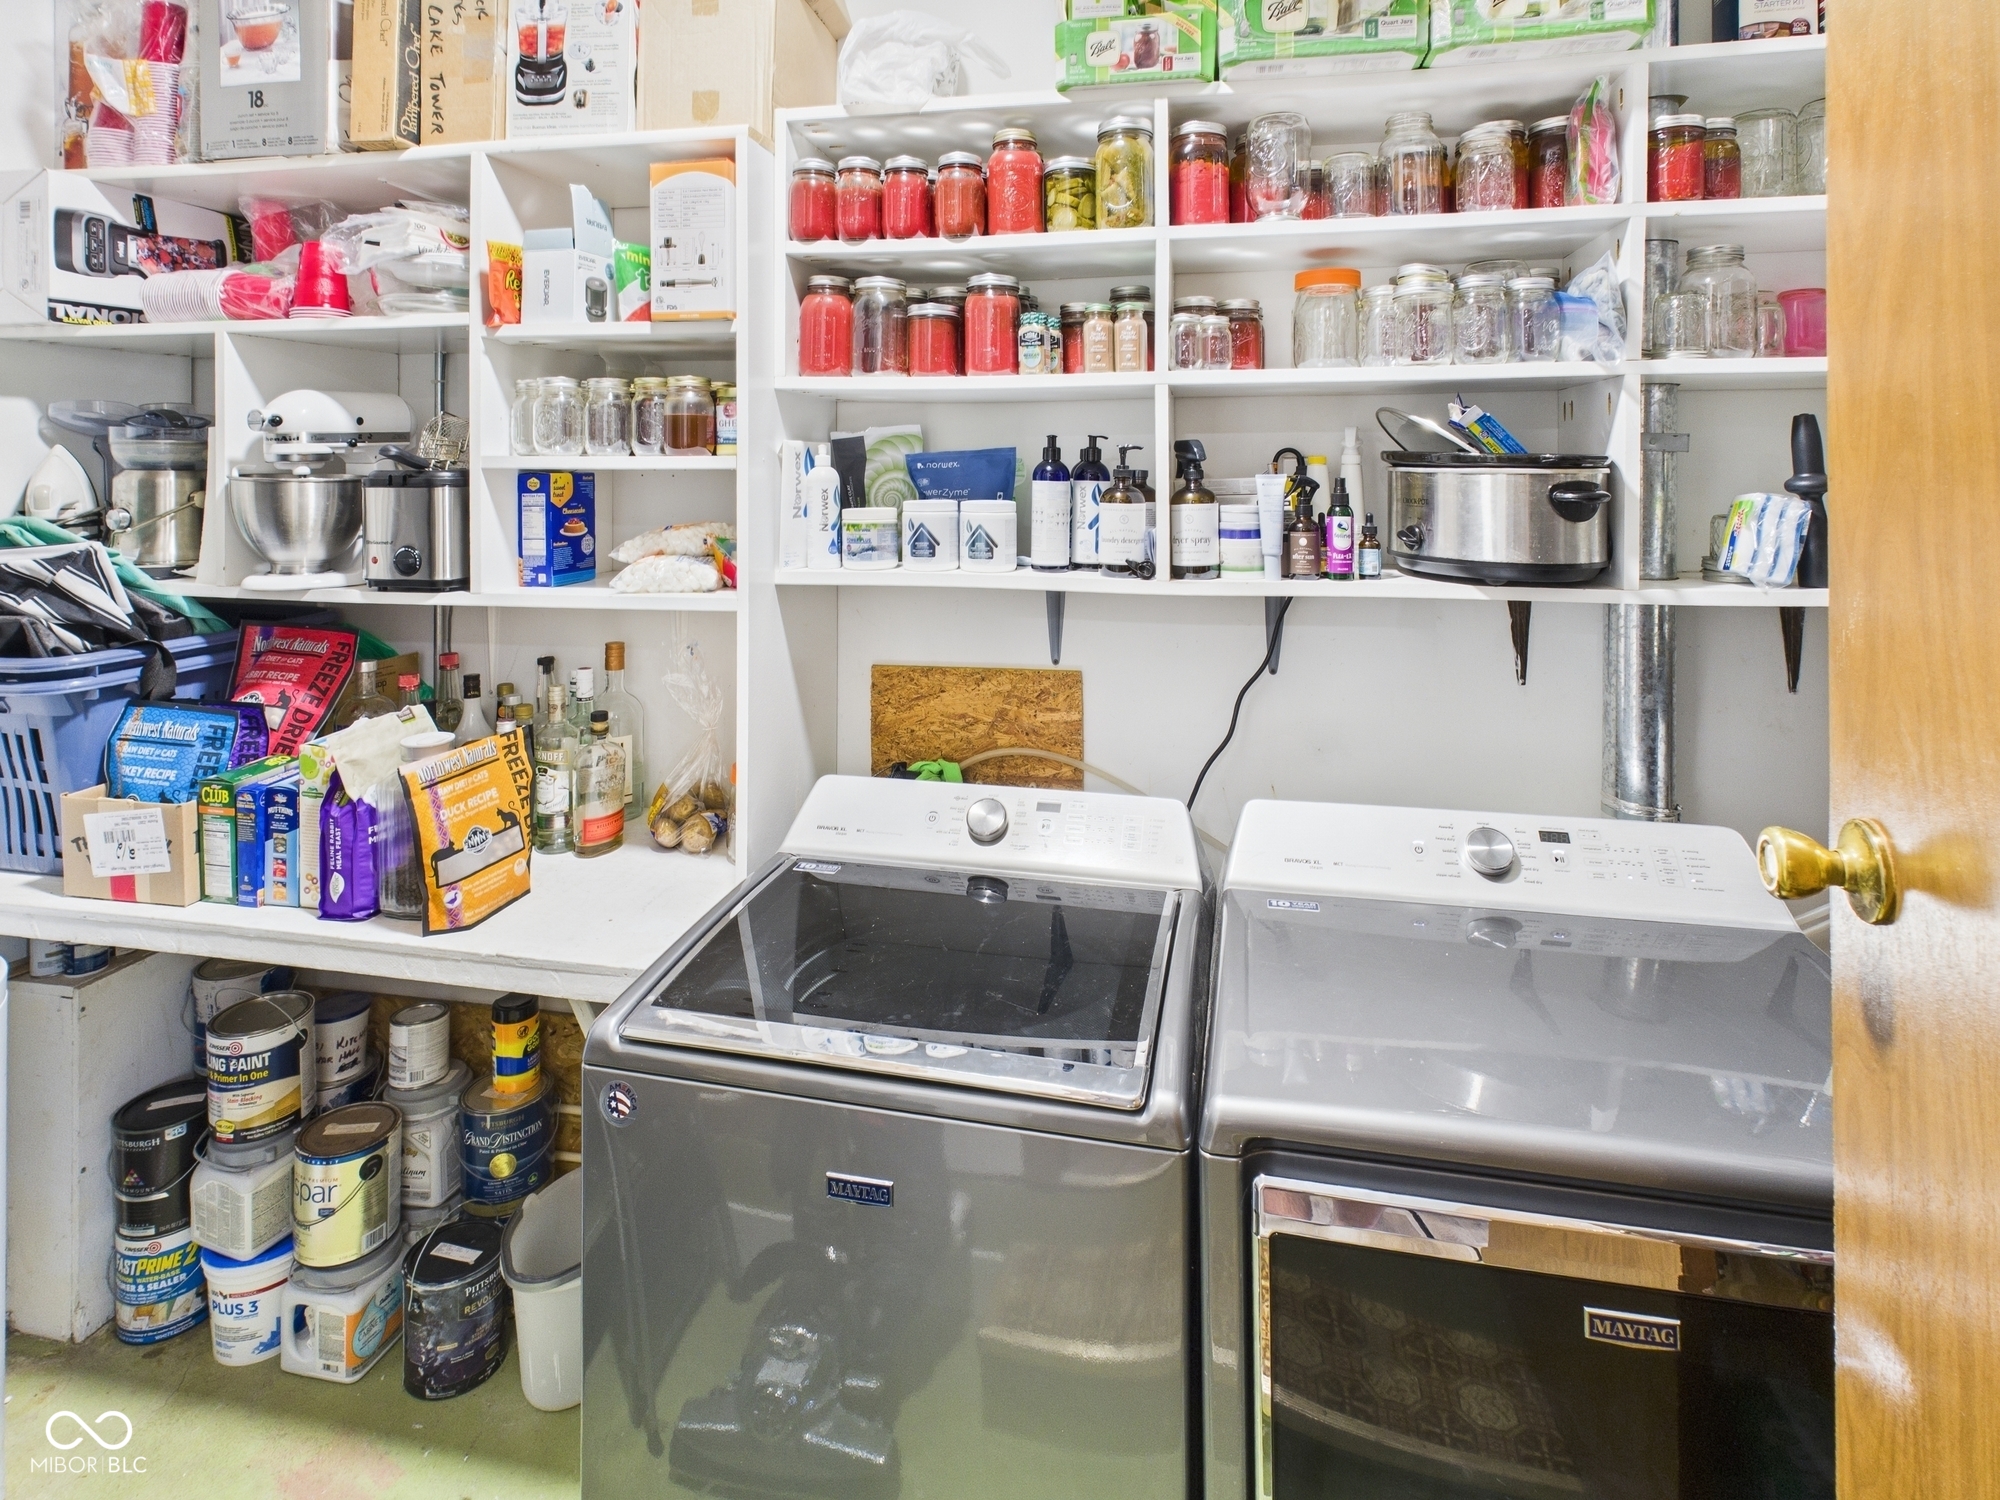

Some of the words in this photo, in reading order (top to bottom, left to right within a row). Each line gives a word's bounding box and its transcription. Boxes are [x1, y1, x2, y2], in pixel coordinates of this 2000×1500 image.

[1268, 0, 1302, 21] Ball
[1754, 0, 1790, 10] STARTER
[405, 29, 421, 69] Chef
[1090, 38, 1116, 58] Ball
[247, 90, 264, 109] 18
[400, 71, 421, 135] Pampered
[430, 72, 446, 135] TOWER
[626, 252, 650, 266] min
[926, 461, 958, 469] norwex
[793, 452, 802, 519] Norwex
[924, 489, 968, 498] werZyme
[820, 488, 828, 532] Norwex
[1077, 486, 1086, 530] Norwex
[1172, 536, 1188, 546] dryer
[1191, 536, 1212, 546] spray
[292, 636, 330, 654] Naturals
[268, 672, 300, 682] RECIPE
[300, 641, 352, 708] FREEZE
[163, 720, 200, 742] Naturals
[240, 715, 261, 766] FREE
[272, 708, 314, 756] DRIE
[138, 746, 154, 756] DIET
[160, 749, 178, 758] CATS
[418, 754, 464, 785] Northwest
[464, 739, 498, 767] Naturals
[537, 751, 565, 762] RNOFF
[121, 766, 145, 777] RKEY
[145, 768, 178, 780] RECIPE
[501, 730, 530, 810] FREEZE
[438, 783, 454, 796] RAW
[454, 778, 468, 792] DIET
[474, 770, 490, 784] CATS
[202, 786, 230, 804] CLUB
[440, 800, 467, 820] DUCK
[468, 786, 500, 808] RECIPE
[798, 862, 816, 870] 10
[208, 1042, 230, 1051] ZINSSER
[338, 1046, 362, 1063] HALL
[229, 1052, 272, 1072] PAINT
[214, 1073, 237, 1083] Primer
[240, 1073, 248, 1082] In
[250, 1069, 269, 1080] One
[240, 1095, 262, 1103] Blocking
[609, 1082, 638, 1112] AMERICA
[118, 1138, 160, 1148] TSBURGH
[464, 1129, 490, 1146] GRAND
[488, 1120, 542, 1149] DISTINCTION
[401, 1166, 426, 1176] tinum
[294, 1176, 338, 1206] spar
[830, 1181, 890, 1204] MAYTAG
[183, 1241, 200, 1267] 2
[136, 1269, 181, 1284] WATER-BASE
[146, 1272, 188, 1292] SEALER
[465, 1269, 501, 1297] PITTSBU
[212, 1299, 244, 1316] PLUS
[248, 1300, 258, 1313] 3
[1592, 1318, 1674, 1344] MAYTAG
